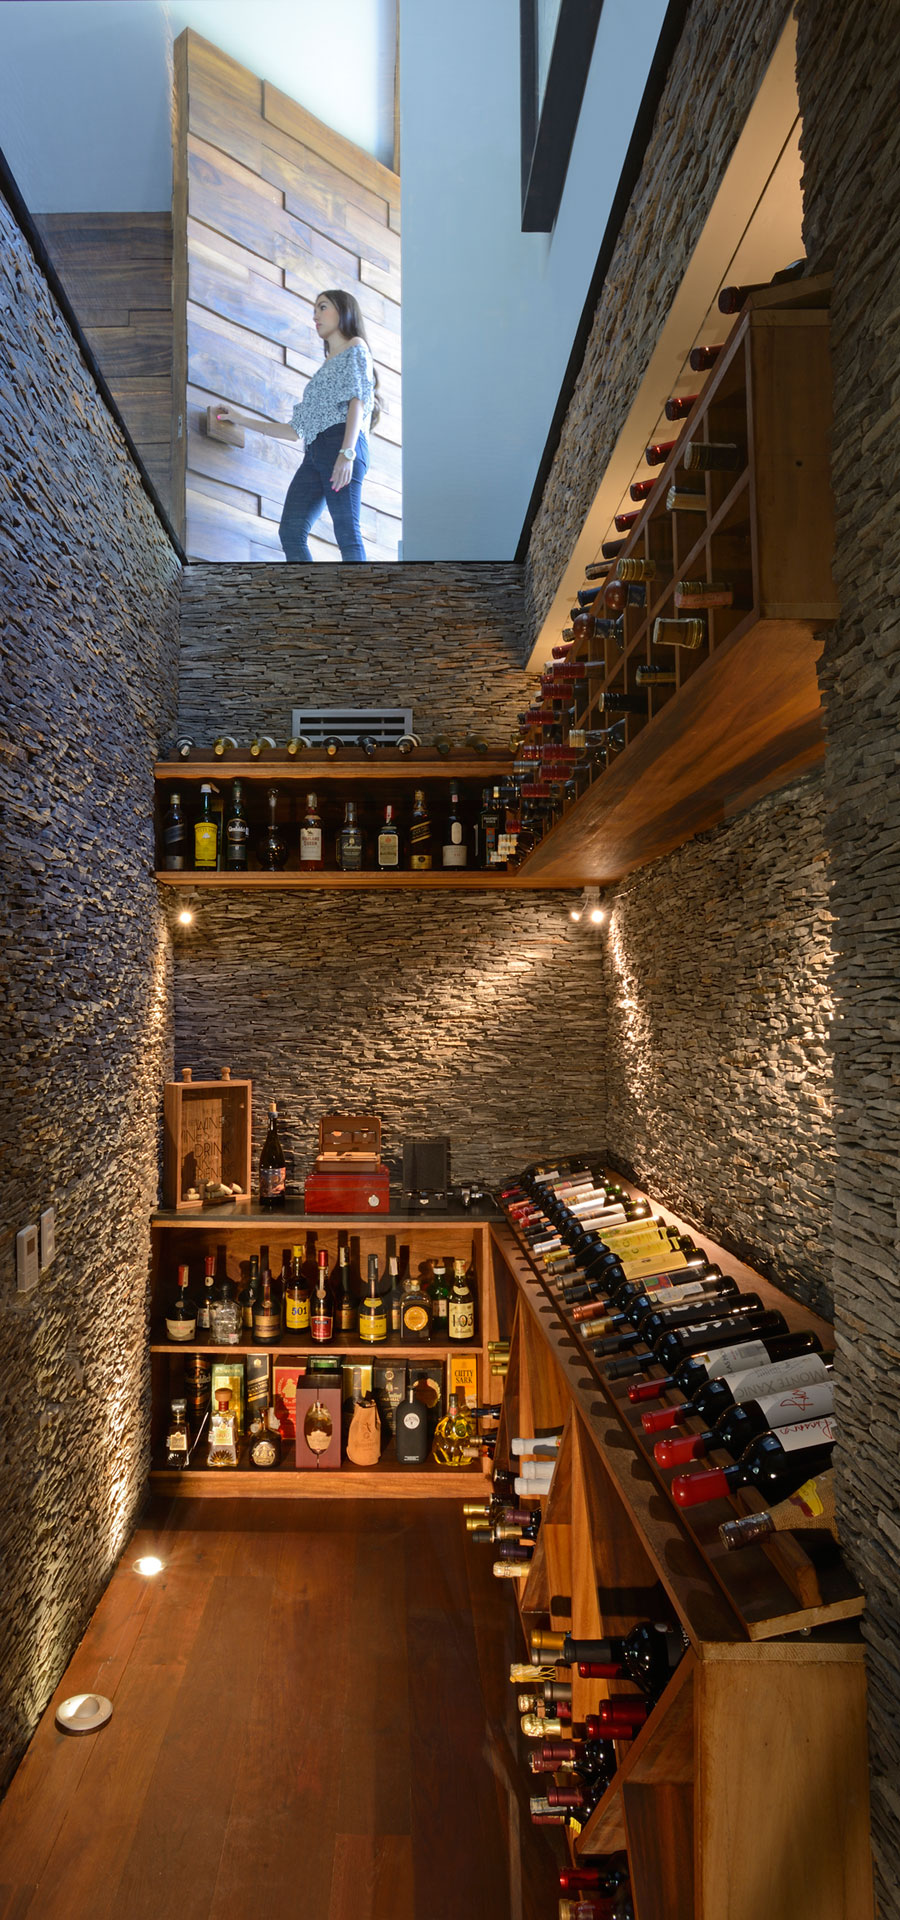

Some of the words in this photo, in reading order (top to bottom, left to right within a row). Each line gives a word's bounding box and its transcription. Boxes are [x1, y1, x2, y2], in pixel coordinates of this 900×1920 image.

[291, 1305, 308, 1317] 501
[452, 1313, 474, 1328] 103
[454, 1369, 473, 1377] CUTTY
[776, 1367, 827, 1388] MONTE
[455, 1376, 473, 1384] SARK
[734, 1380, 775, 1399] XANIC
